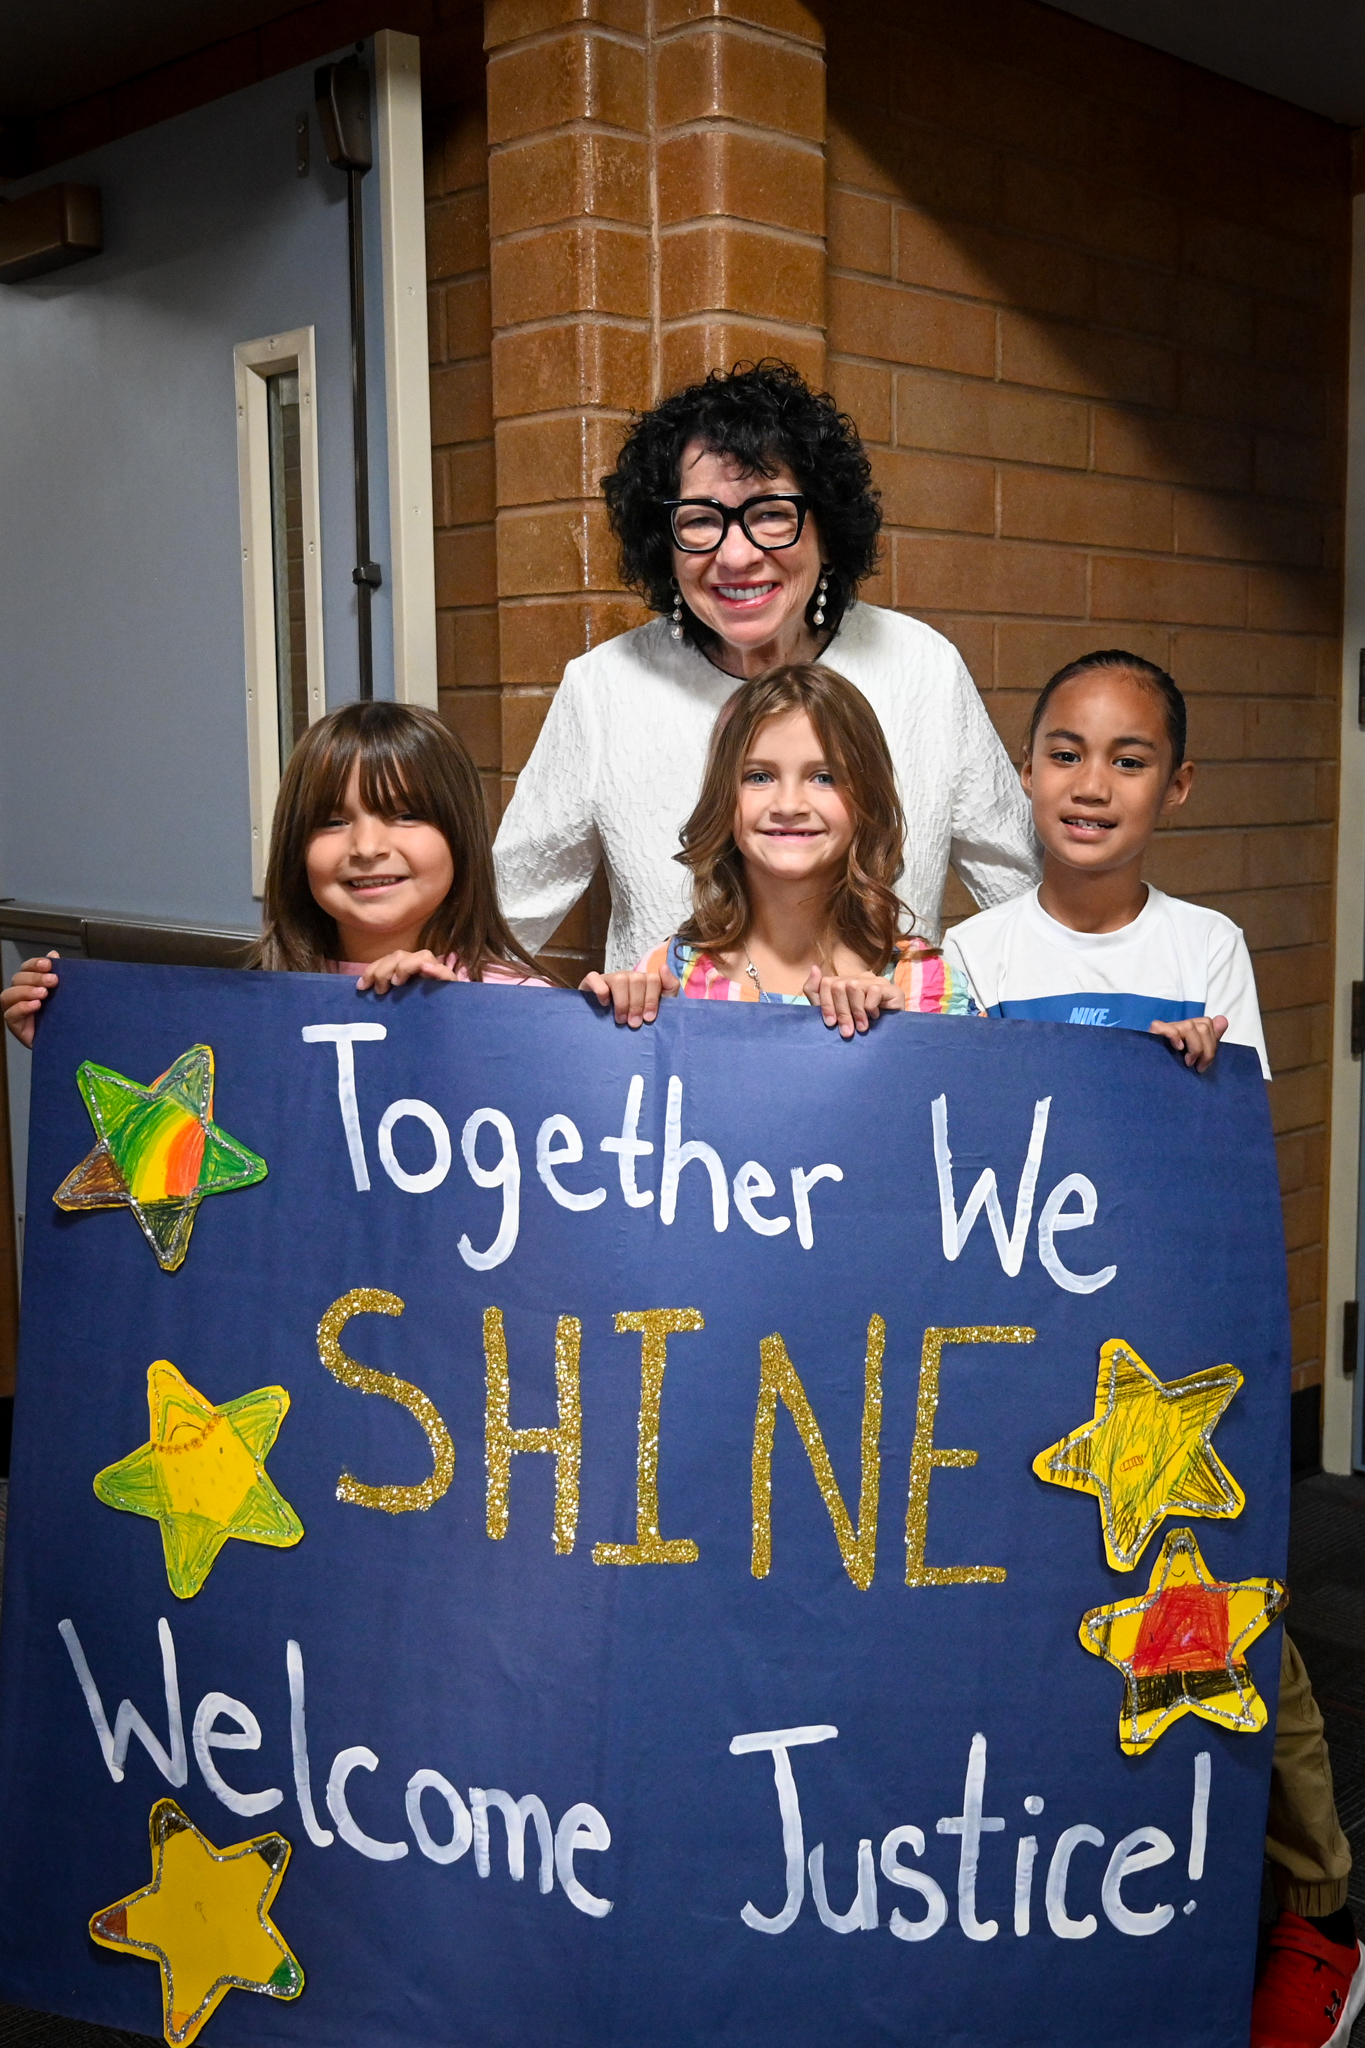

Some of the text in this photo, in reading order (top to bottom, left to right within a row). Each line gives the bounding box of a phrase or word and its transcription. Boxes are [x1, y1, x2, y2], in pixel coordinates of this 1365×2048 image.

[301, 1022, 1118, 1295] Together We
[1069, 1007, 1110, 1026] NIKE
[316, 1287, 1038, 1592] SHINE
[58, 1616, 1212, 1943] Welcome Justice!
